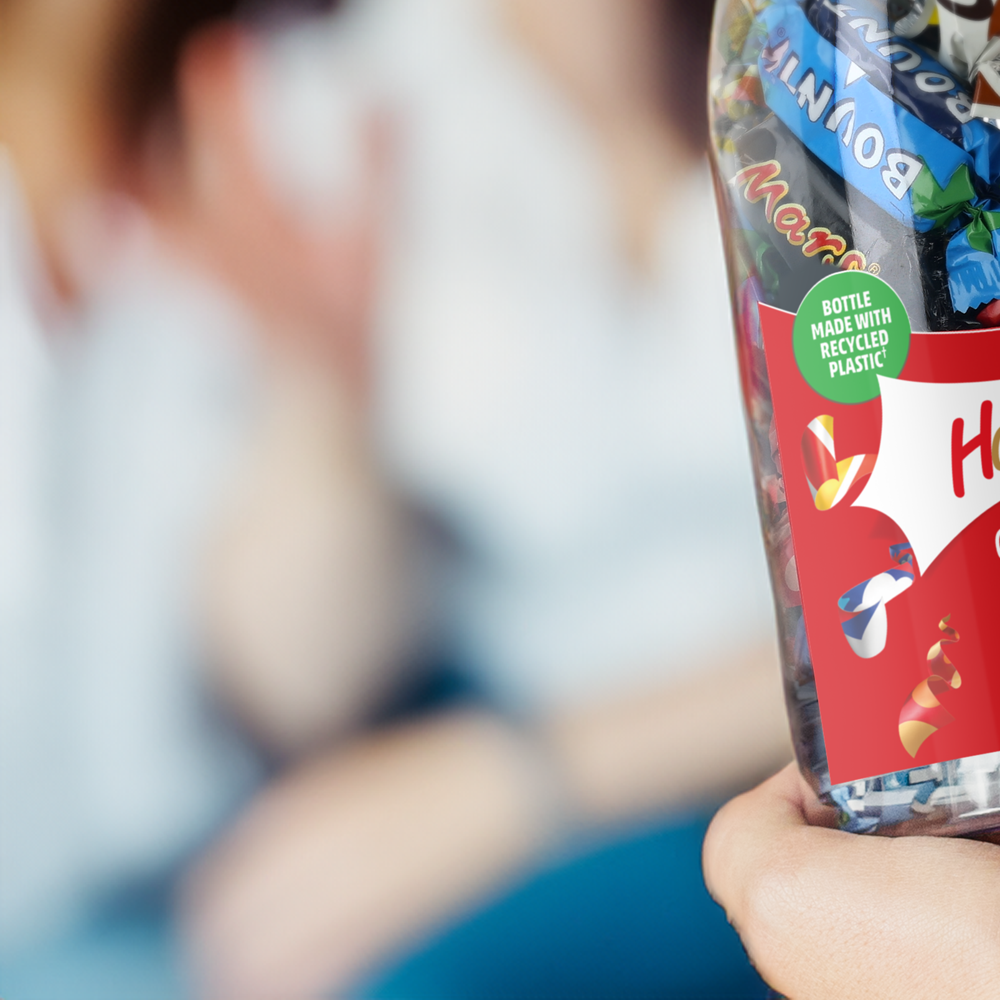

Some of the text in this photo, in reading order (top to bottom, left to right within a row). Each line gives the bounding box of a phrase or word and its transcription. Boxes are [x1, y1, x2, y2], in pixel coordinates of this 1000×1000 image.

[761, 38, 924, 200] BOUNTY
[821, 290, 872, 316] BOTTLE
[811, 307, 892, 340] MADE WITH
[820, 329, 889, 359] RECYCLED
